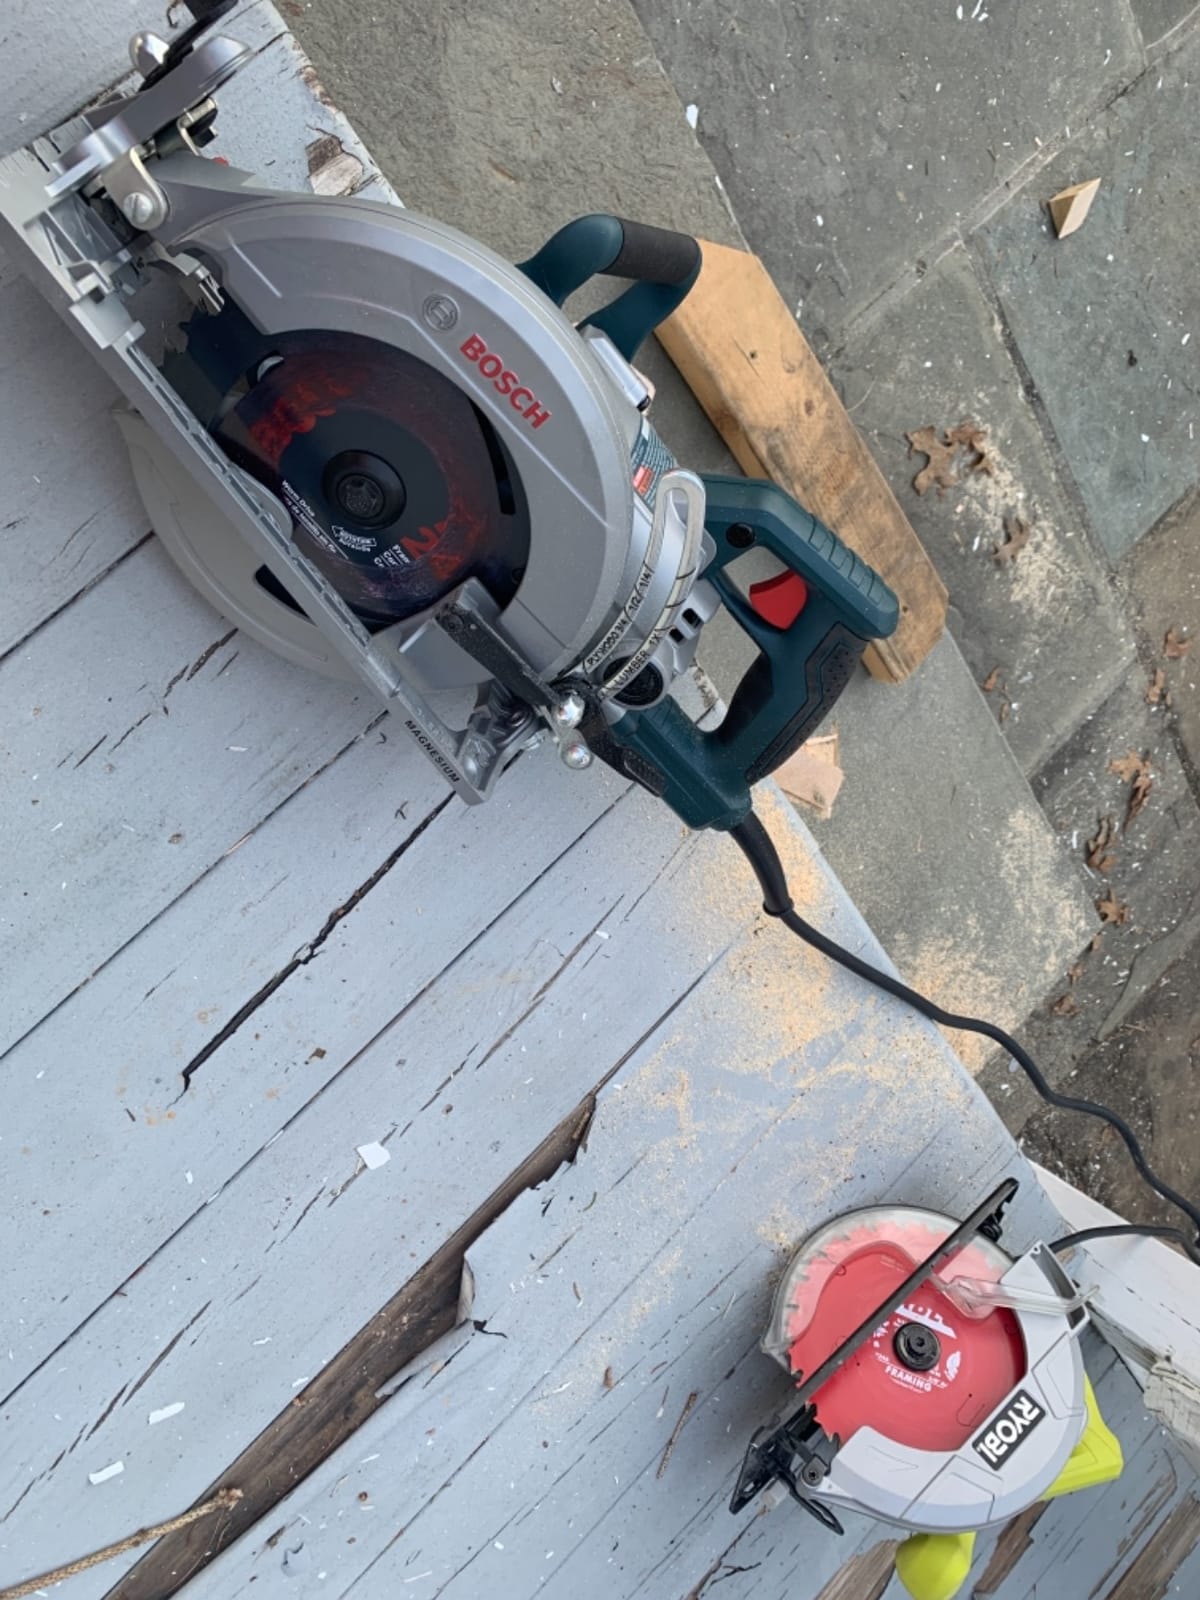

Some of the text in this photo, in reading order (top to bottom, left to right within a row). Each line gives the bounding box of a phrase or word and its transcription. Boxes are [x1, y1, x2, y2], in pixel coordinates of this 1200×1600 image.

[460, 332, 551, 429] BOSCH
[614, 650, 650, 687] LUMBER
[404, 720, 460, 782] MAGNESIUM
[885, 1365, 932, 1393] FRAMING
[976, 1396, 1041, 1463] RYOBI
